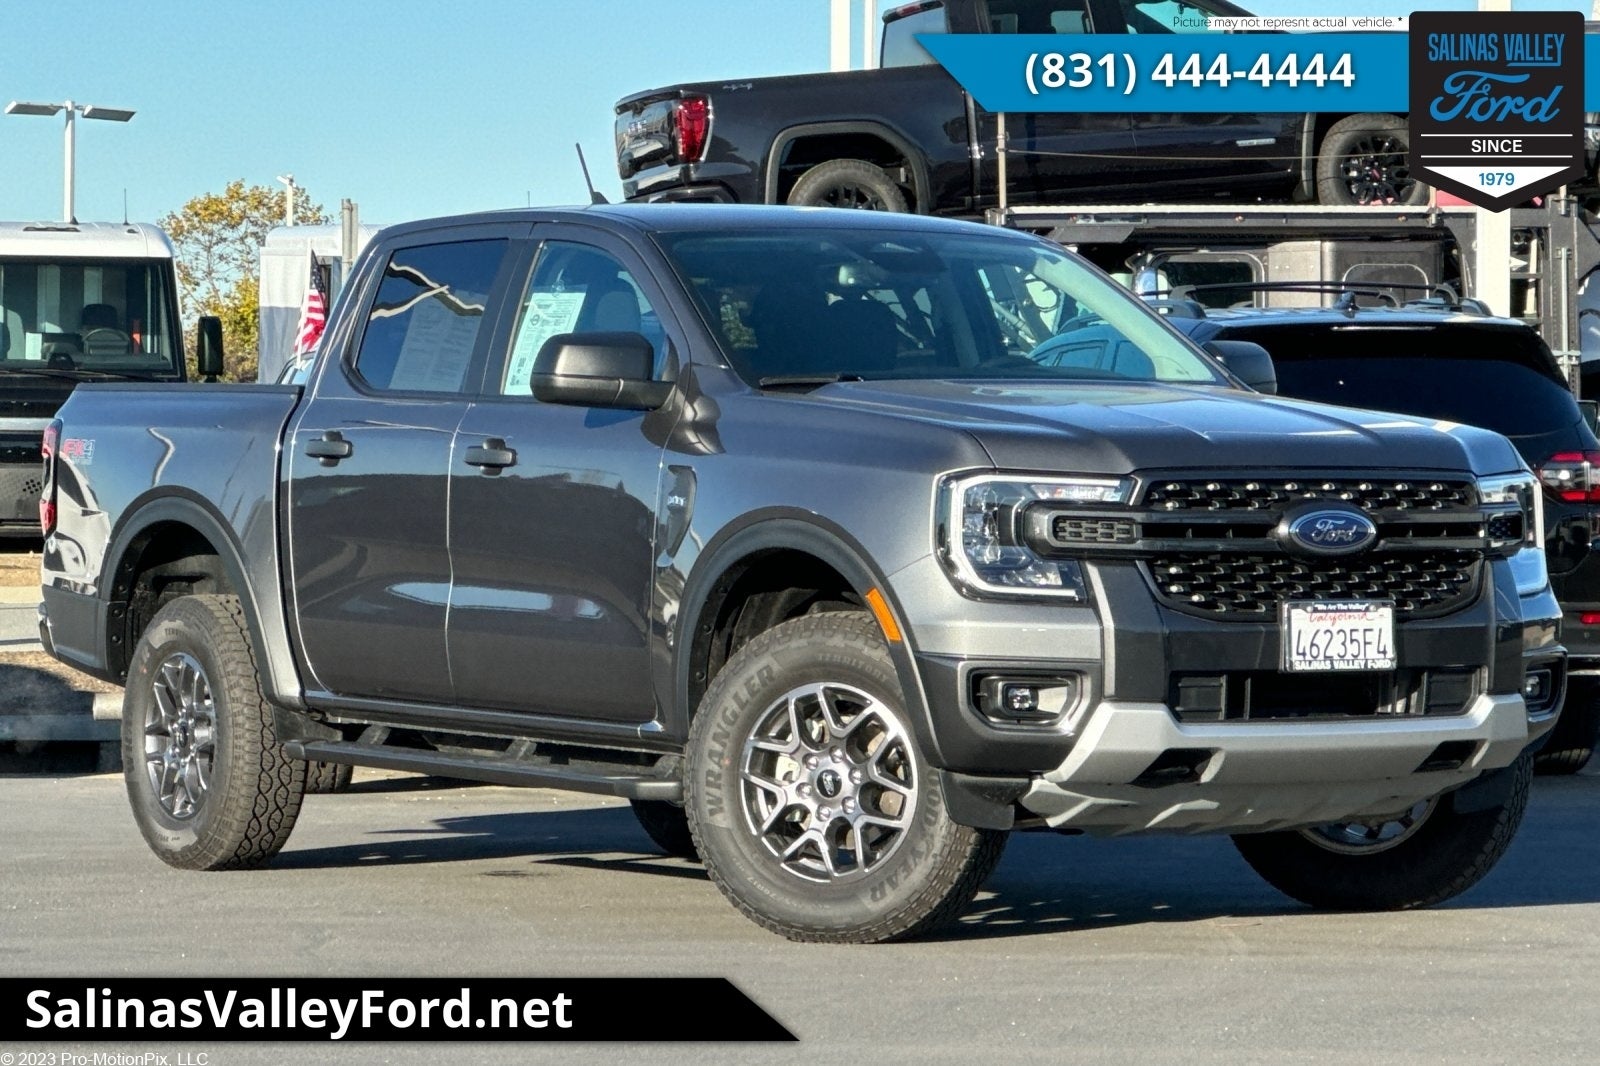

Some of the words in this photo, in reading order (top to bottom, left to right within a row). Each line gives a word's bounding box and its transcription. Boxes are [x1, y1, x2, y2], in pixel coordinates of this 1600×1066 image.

[1312, 519, 1357, 542] Ford
[1309, 612, 1374, 626] California
[1296, 628, 1388, 660] 46235F4
[1294, 659, 1331, 670] SALINAS
[1333, 659, 1365, 670] VALLEY
[1367, 659, 1392, 669] FORD
[705, 664, 777, 817] WRANGLER
